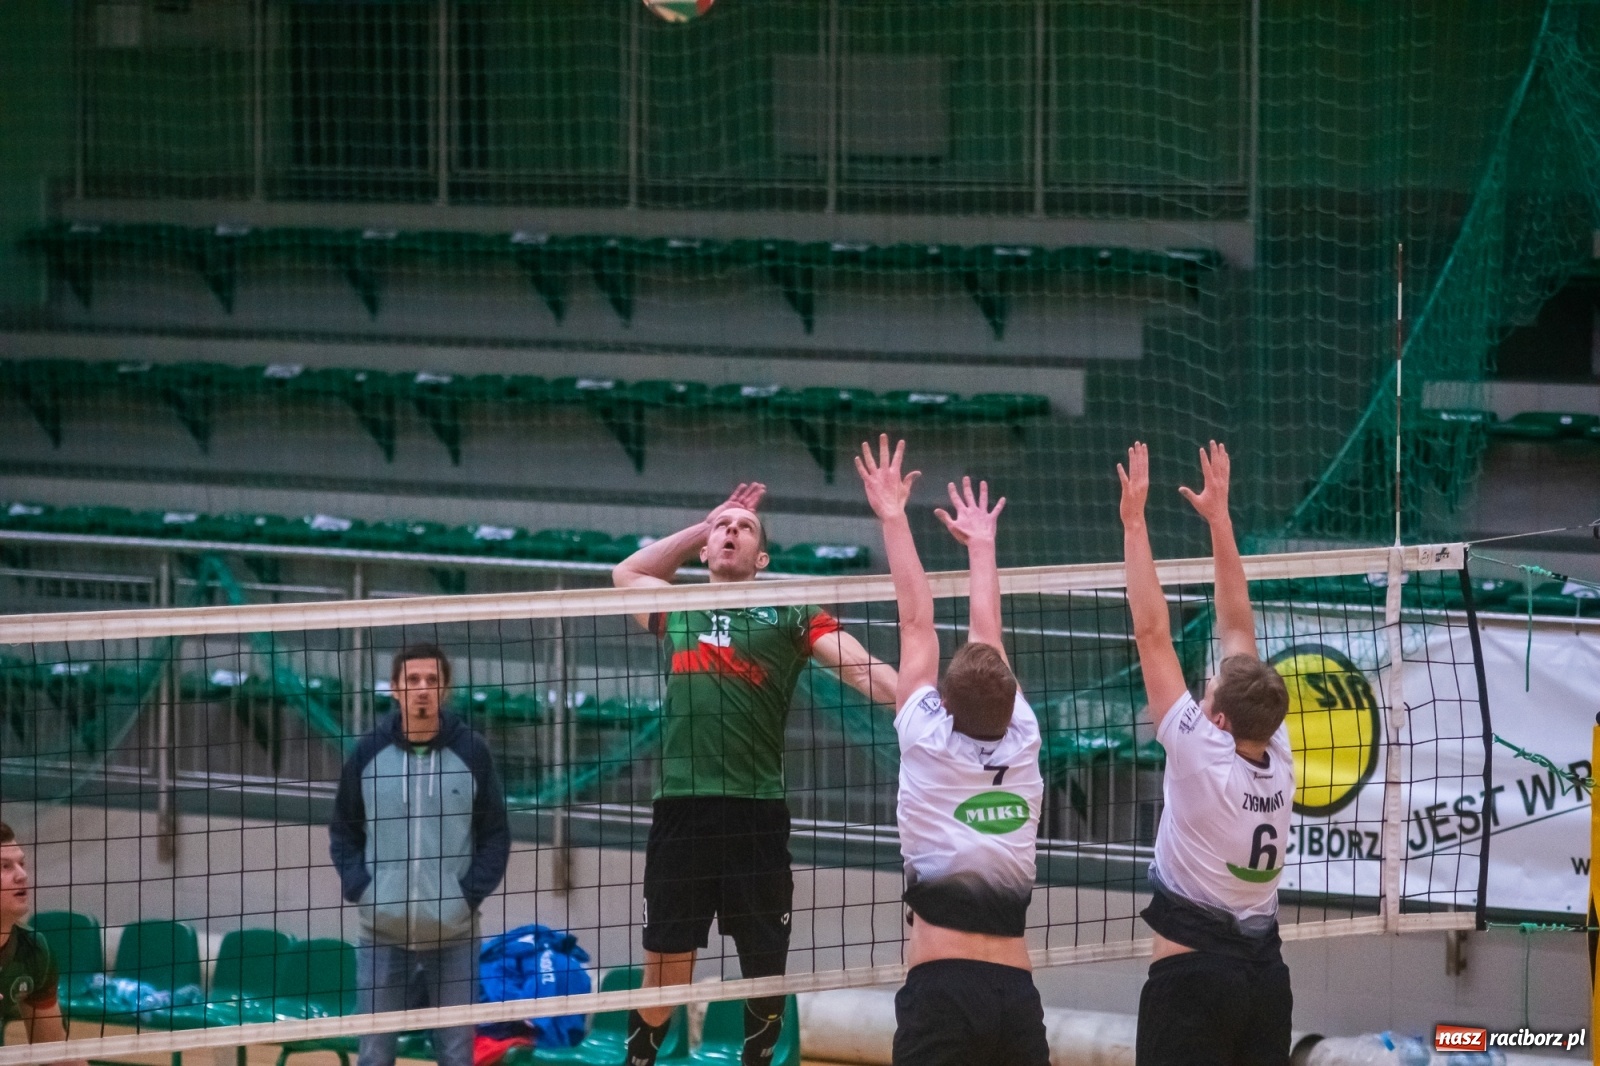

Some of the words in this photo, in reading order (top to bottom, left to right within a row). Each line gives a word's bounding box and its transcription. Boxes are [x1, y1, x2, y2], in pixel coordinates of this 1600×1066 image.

[983, 765, 1010, 786] 7
[965, 804, 1026, 824] MIKI
[1409, 785, 1505, 851] JEST
[1516, 770, 1557, 817] W
[1248, 823, 1278, 871] 6
